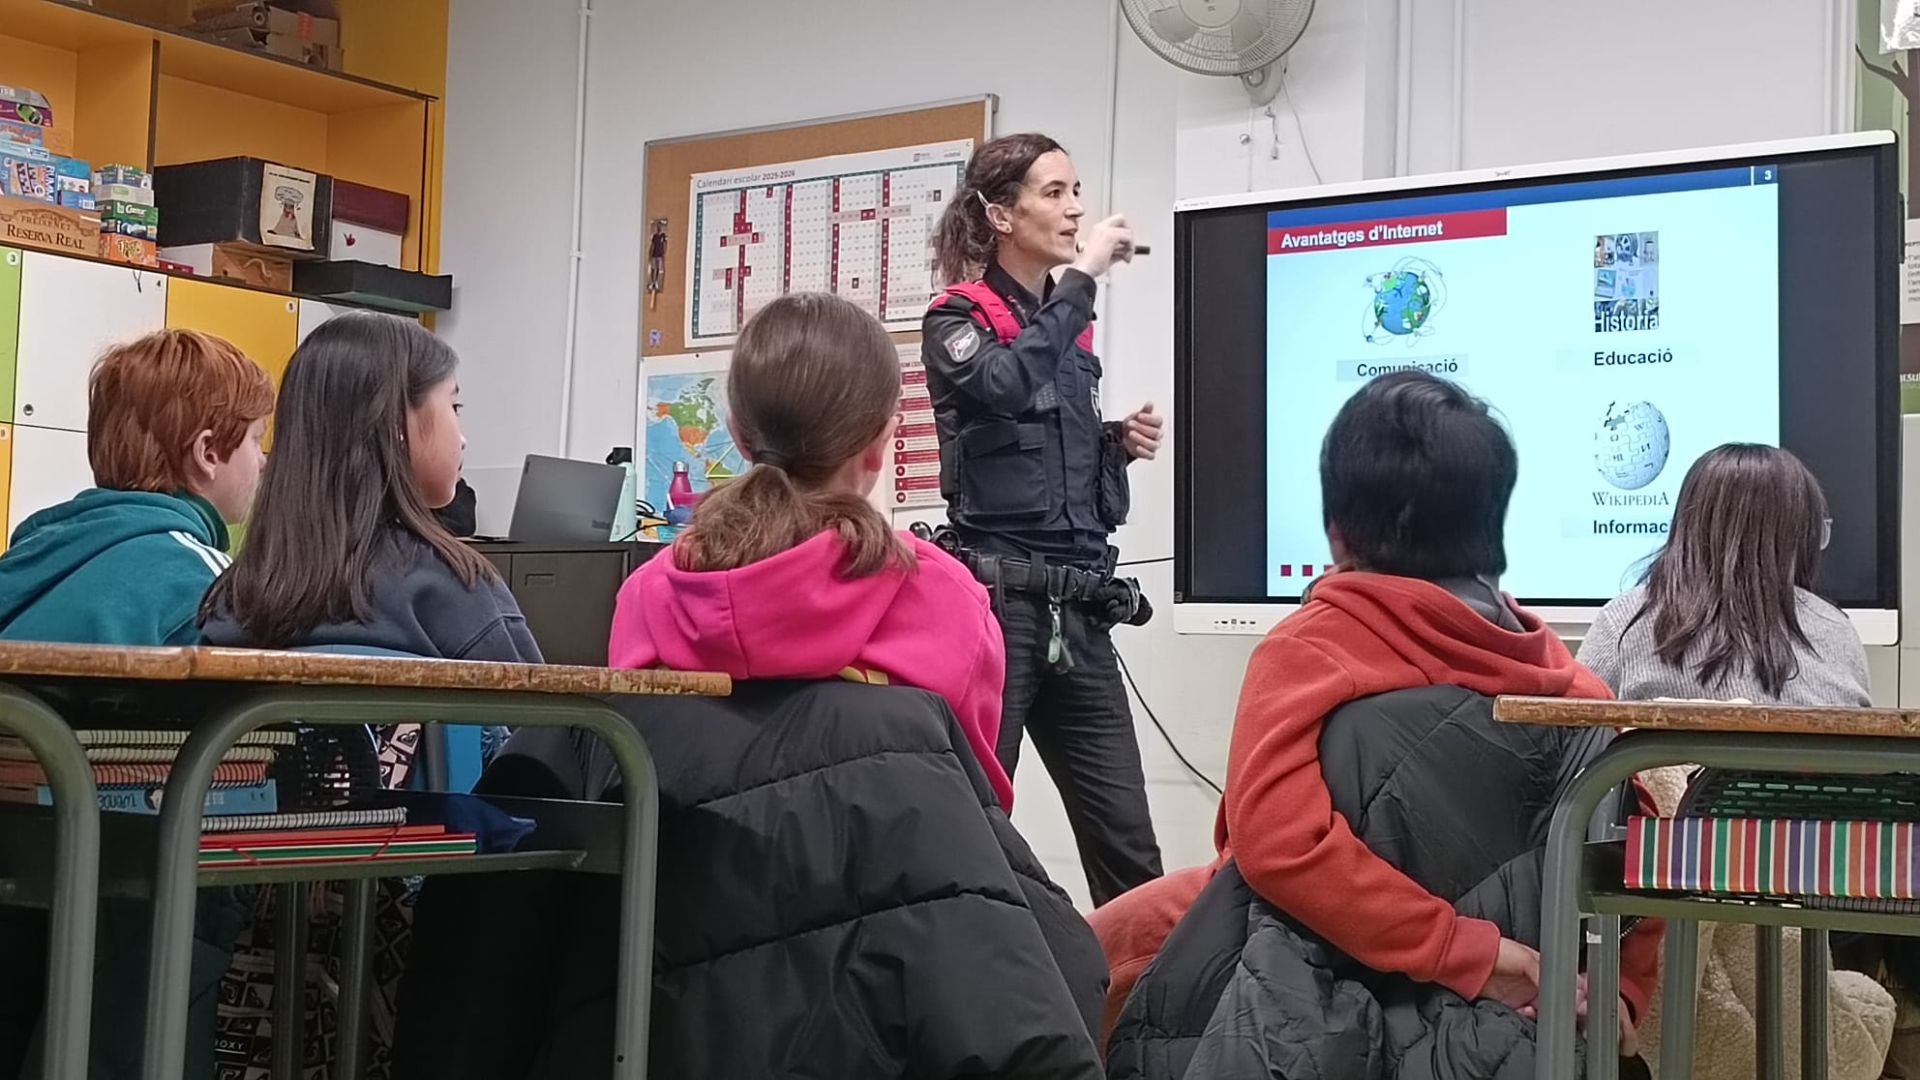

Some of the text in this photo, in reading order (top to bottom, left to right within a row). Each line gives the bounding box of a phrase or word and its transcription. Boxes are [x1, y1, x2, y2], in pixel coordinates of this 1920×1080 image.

[697, 177, 733, 189] Calendari
[734, 173, 761, 184] escolar
[1764, 169, 1772, 181] 3
[7, 223, 85, 250] RESERVA REAL
[1281, 229, 1365, 249] Avantatges
[1594, 347, 1673, 366] Educació
[1592, 491, 1669, 506] WIKIPEDIA
[1593, 519, 1669, 534] Informac
